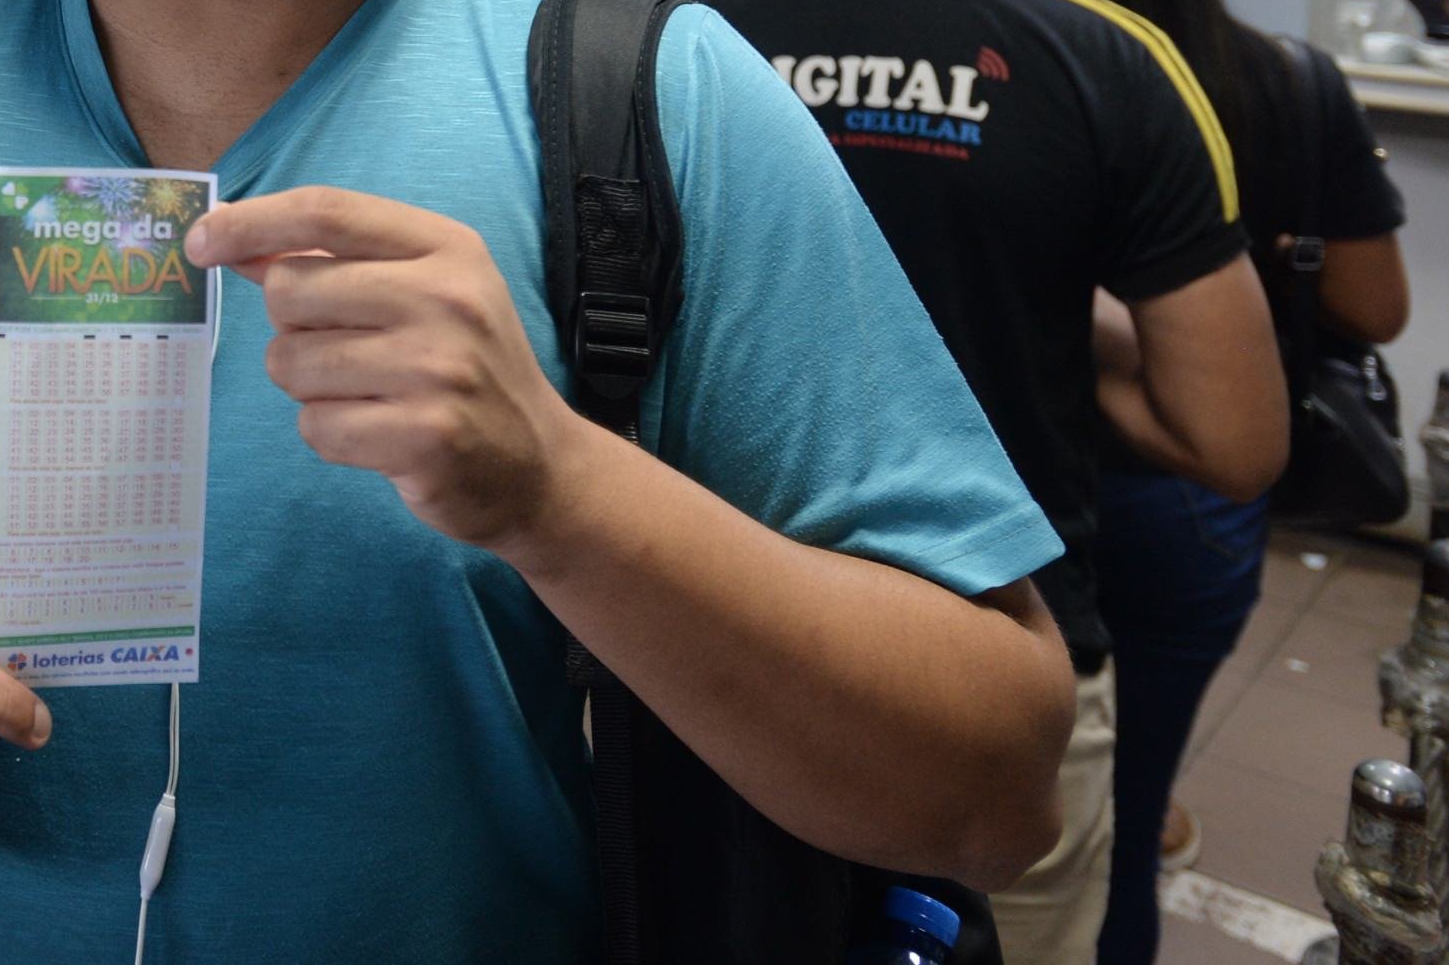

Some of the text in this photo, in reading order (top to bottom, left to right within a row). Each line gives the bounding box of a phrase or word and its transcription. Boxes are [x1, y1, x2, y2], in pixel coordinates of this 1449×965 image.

[845, 109, 982, 146] CELULAR
[34, 214, 173, 244] mega da
[12, 245, 192, 294] VIRADA
[32, 644, 180, 669] loterias CAIXA
